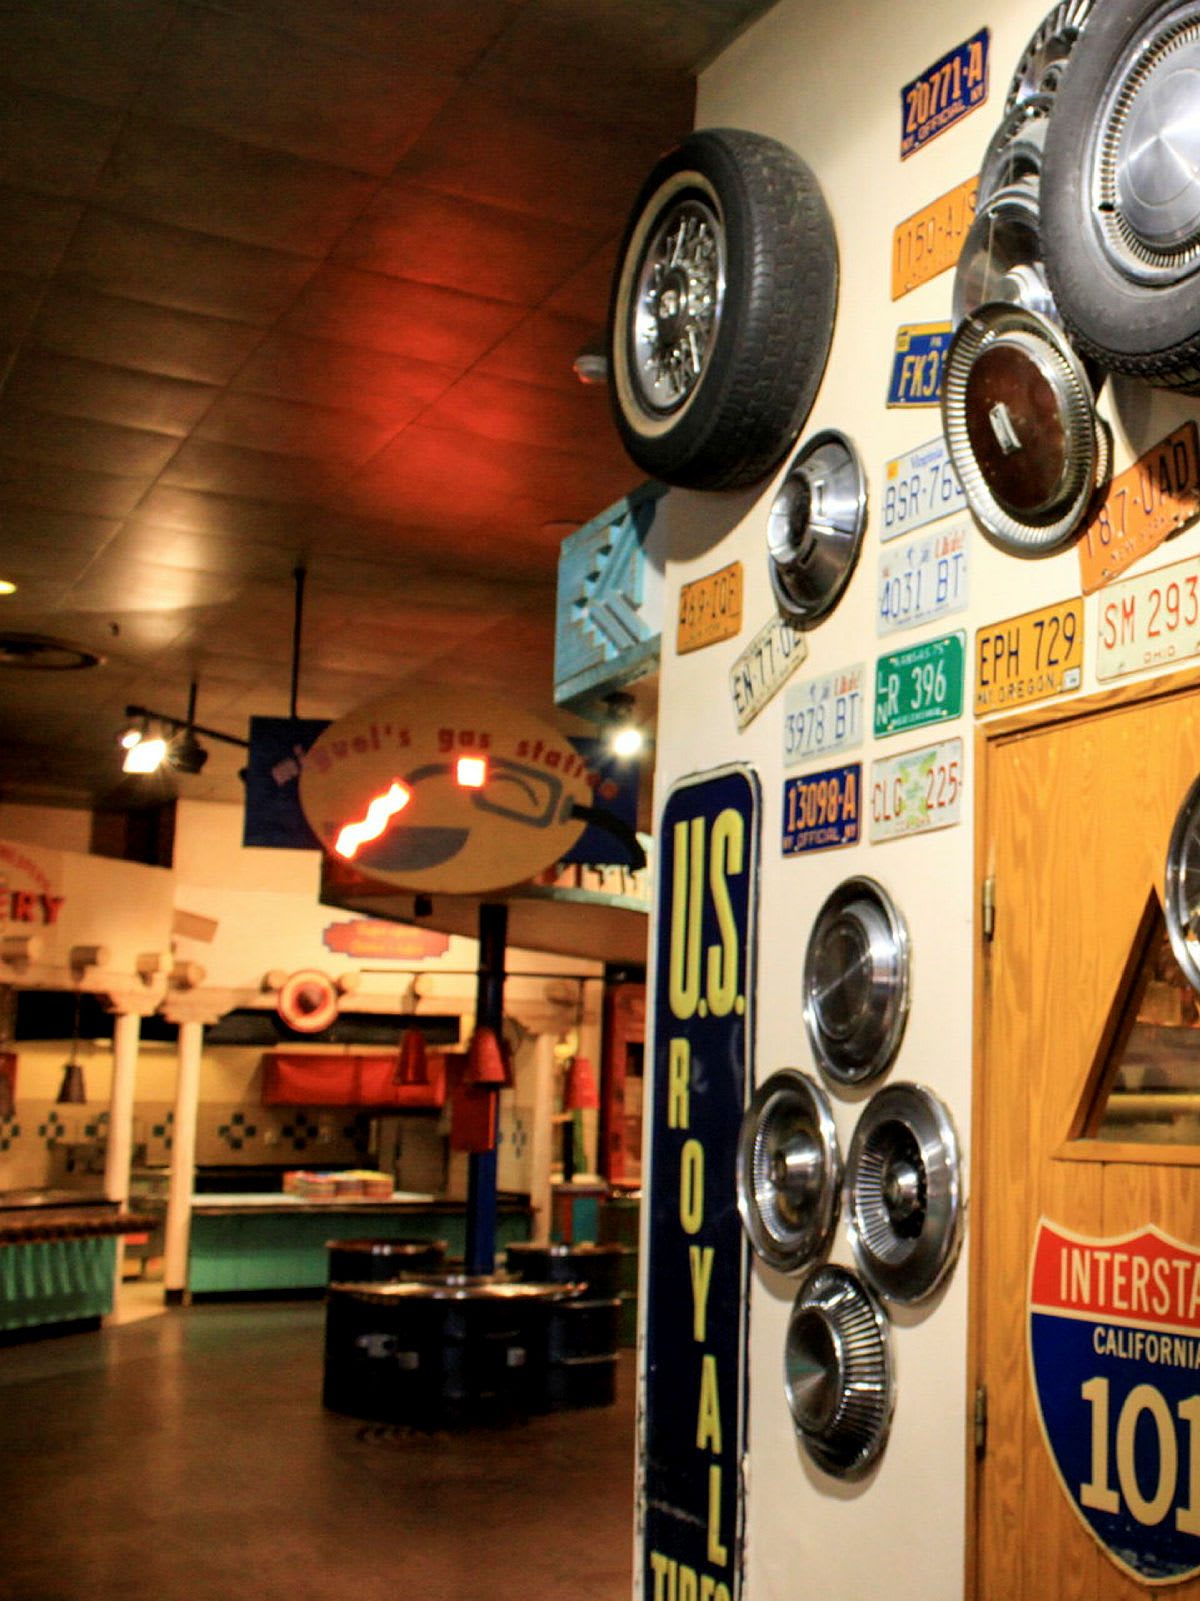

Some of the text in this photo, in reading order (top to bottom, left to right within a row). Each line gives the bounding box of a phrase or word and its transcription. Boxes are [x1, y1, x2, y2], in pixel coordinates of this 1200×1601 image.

[935, 552, 964, 603] BT
[1104, 594, 1136, 650] SM
[979, 611, 1078, 687] EPH 729
[910, 659, 947, 709] 396
[999, 673, 1055, 703] OREGON
[437, 726, 492, 754] gas
[834, 692, 860, 739] BT
[925, 762, 959, 809] 225
[668, 807, 746, 1021] U.S.
[667, 1036, 728, 1568] ROYAL
